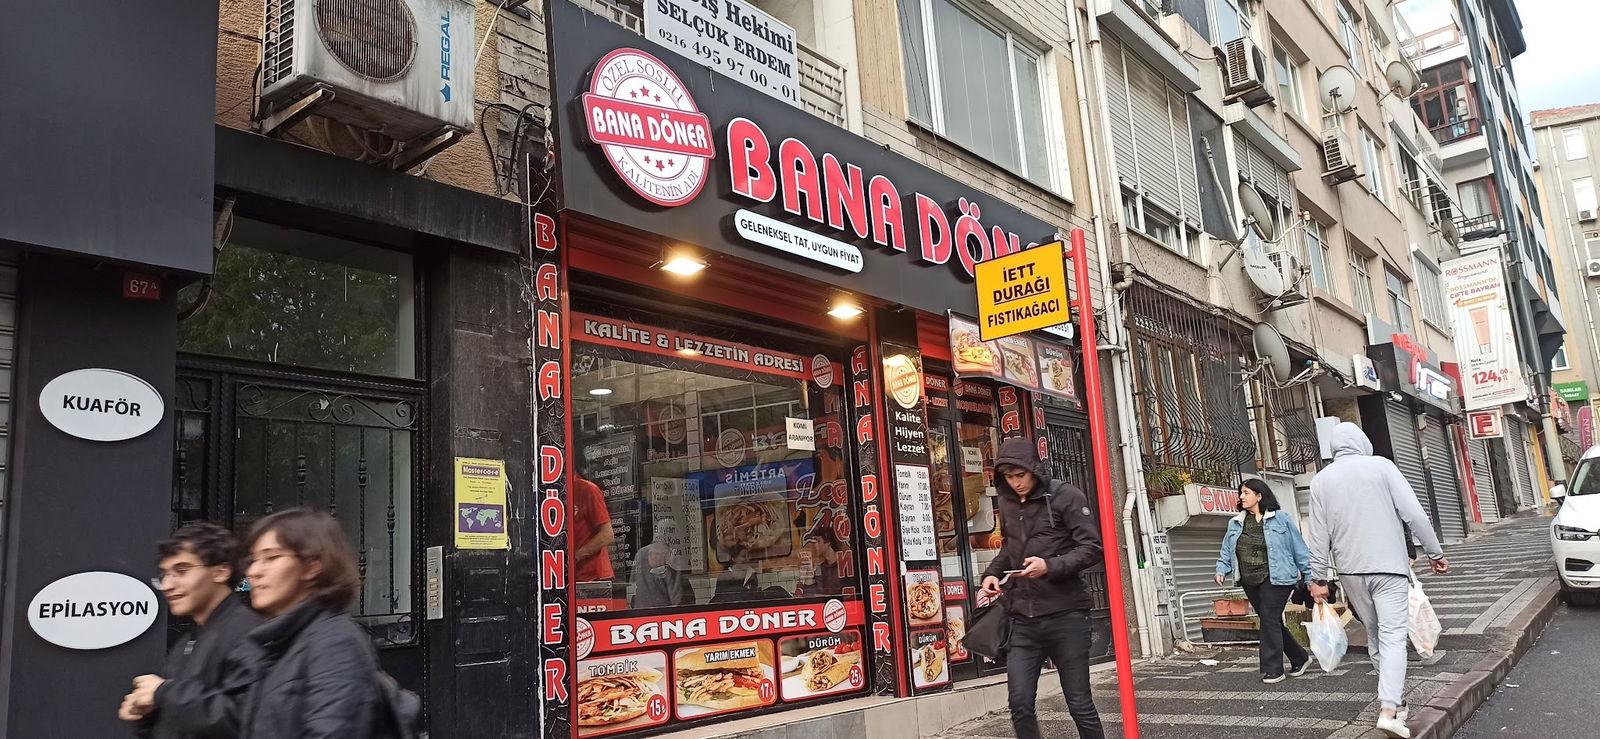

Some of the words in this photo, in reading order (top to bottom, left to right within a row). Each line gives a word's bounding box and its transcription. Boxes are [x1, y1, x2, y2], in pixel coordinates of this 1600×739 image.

[440, 10, 451, 82] REGAL
[657, 0, 729, 47] SELÇUK
[733, 35, 792, 78] ERDEM
[725, 0, 794, 55] Hekimi
[601, 59, 634, 92] ÖZEL
[637, 60, 683, 103] SOSLU
[658, 28, 687, 49] 0216
[692, 41, 721, 65] 495
[727, 57, 745, 76] 97
[750, 69, 767, 87] 00
[782, 84, 796, 101] 01
[592, 106, 645, 140] BANA
[646, 112, 708, 149] DÖNER
[617, 156, 683, 197] KALİTENİN
[685, 170, 699, 192] ADI
[726, 116, 907, 253] BANA
[915, 196, 1056, 278] DÖN
[740, 218, 792, 243] GELENEKSEL
[794, 235, 811, 251] TAT,
[811, 241, 838, 258] UYGUN
[840, 249, 859, 265] FİYAT
[1003, 262, 1036, 283] İETT
[1445, 257, 1498, 277] ROSSMANN
[534, 212, 561, 401] BANA
[993, 276, 1050, 304] DURAĞI
[987, 298, 1060, 328] FISTIKAĞACI
[584, 319, 651, 345] KALİTE
[656, 333, 669, 348] &
[675, 337, 749, 363] LEZZETİN
[753, 352, 804, 373] ADRESİ
[851, 345, 873, 444] ANA
[925, 375, 946, 389] DÖNER
[62, 394, 142, 417] KUAFÖR
[895, 411, 922, 424] Kalite
[999, 386, 1021, 441] BA
[1032, 390, 1049, 461] ANA
[894, 426, 924, 440] Hijyen
[897, 441, 925, 454] Lezzet
[1214, 489, 1241, 512] KUN
[540, 445, 568, 703] DÖNER
[861, 474, 890, 653] DÖNER
[38, 599, 149, 619] EPİLASYON
[610, 617, 707, 645] BANA
[718, 608, 817, 635] DÖNER
[704, 650, 729, 663] YARIM
[730, 647, 756, 660] EKMEK
[808, 636, 841, 649] DÜRÜM
[588, 658, 639, 678] TOMBİK
